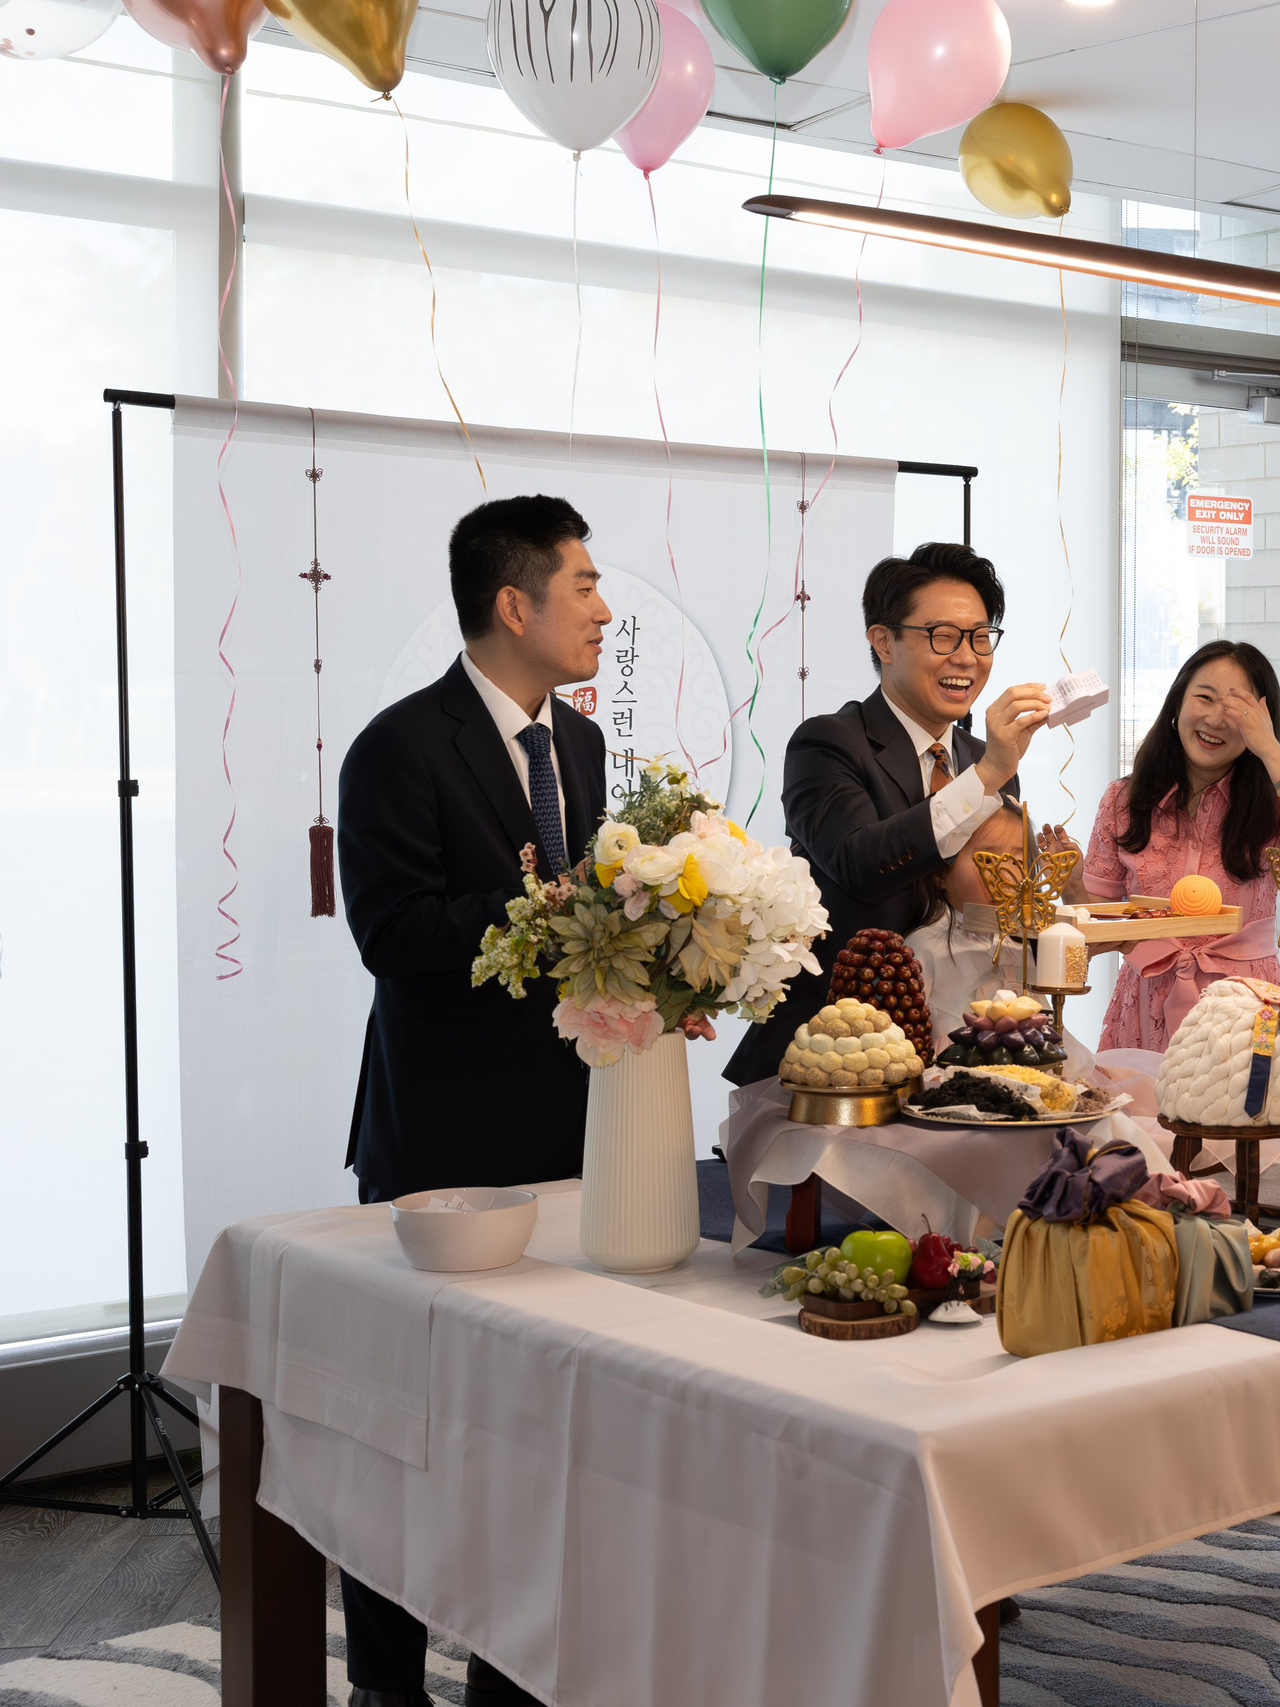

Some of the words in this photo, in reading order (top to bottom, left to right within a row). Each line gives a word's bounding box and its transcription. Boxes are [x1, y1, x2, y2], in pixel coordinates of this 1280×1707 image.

[1189, 499, 1250, 511] EMERGENCY
[1195, 510, 1216, 519] EXIT
[1219, 511, 1245, 521] ONLY
[1192, 525, 1224, 534] SECURITY
[1225, 527, 1248, 536] ALARM
[1200, 536, 1215, 544] WILL
[1217, 537, 1240, 546] SOUND
[1188, 545, 1195, 554] IF
[1196, 546, 1215, 555] DOOR
[1217, 547, 1223, 555] IS
[1224, 547, 1251, 557] OPENED
[611, 615, 641, 738] 사랑스런
